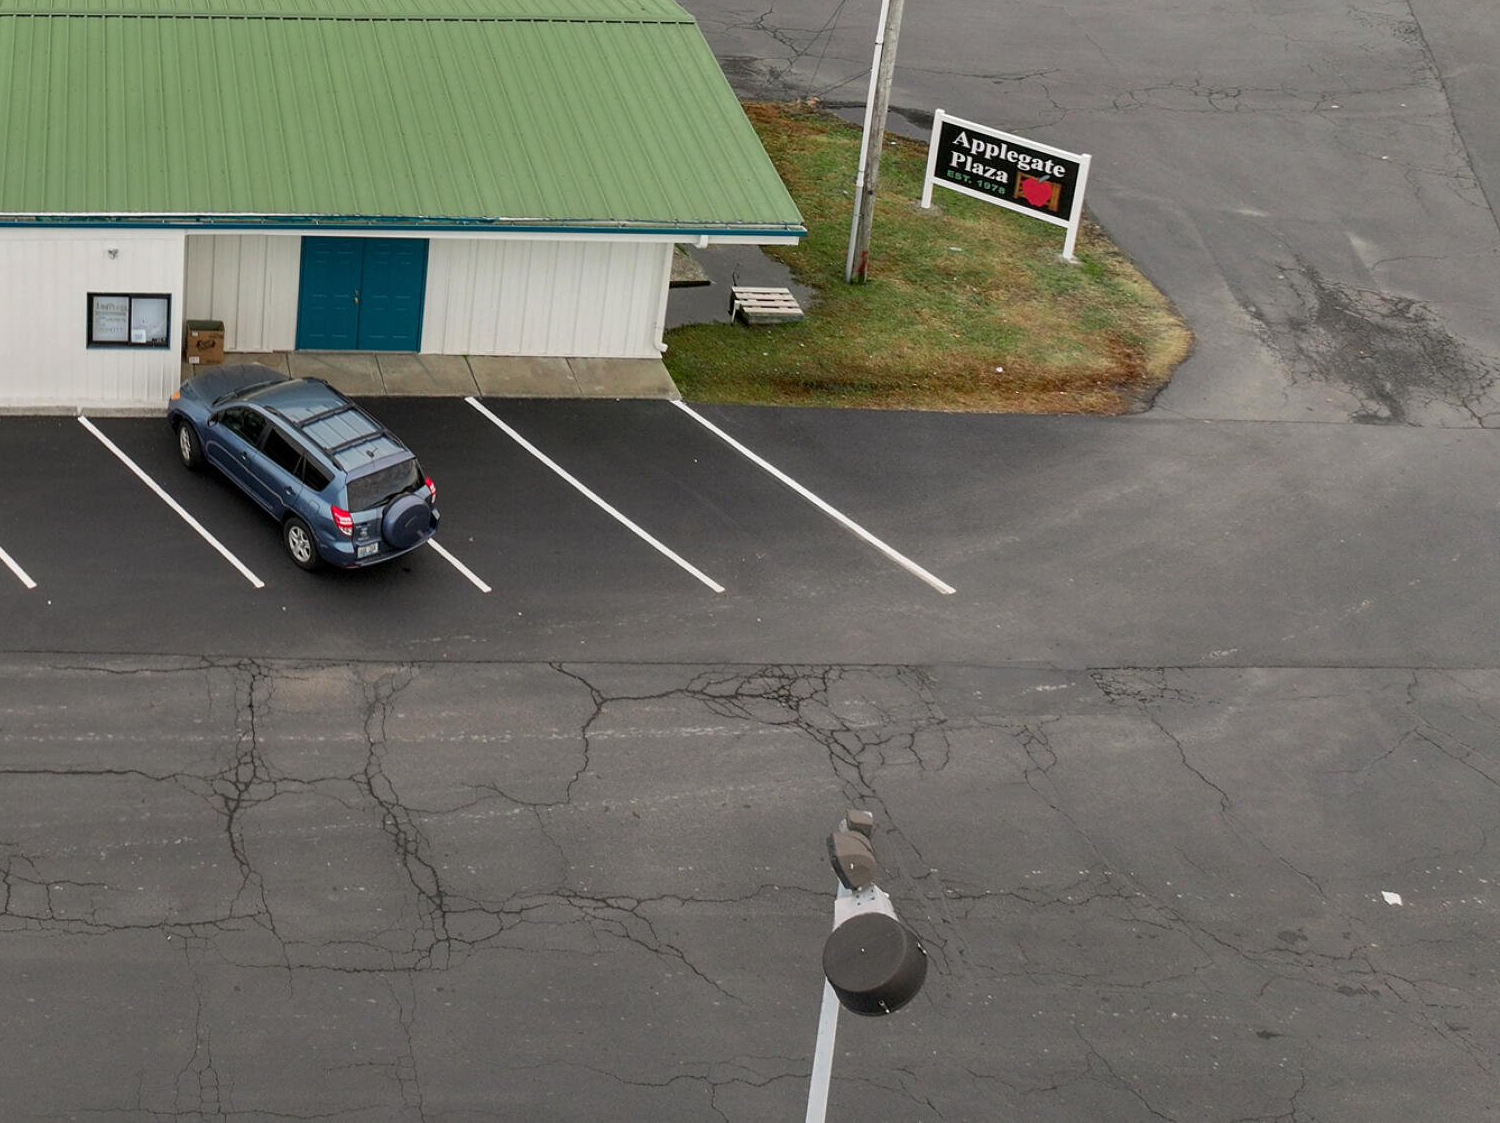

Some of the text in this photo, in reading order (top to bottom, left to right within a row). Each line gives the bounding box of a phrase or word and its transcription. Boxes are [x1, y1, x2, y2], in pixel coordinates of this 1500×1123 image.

[949, 151, 1009, 184] Plaza
[952, 131, 1066, 178] Applegate
[946, 169, 1006, 195] EST. 1978
